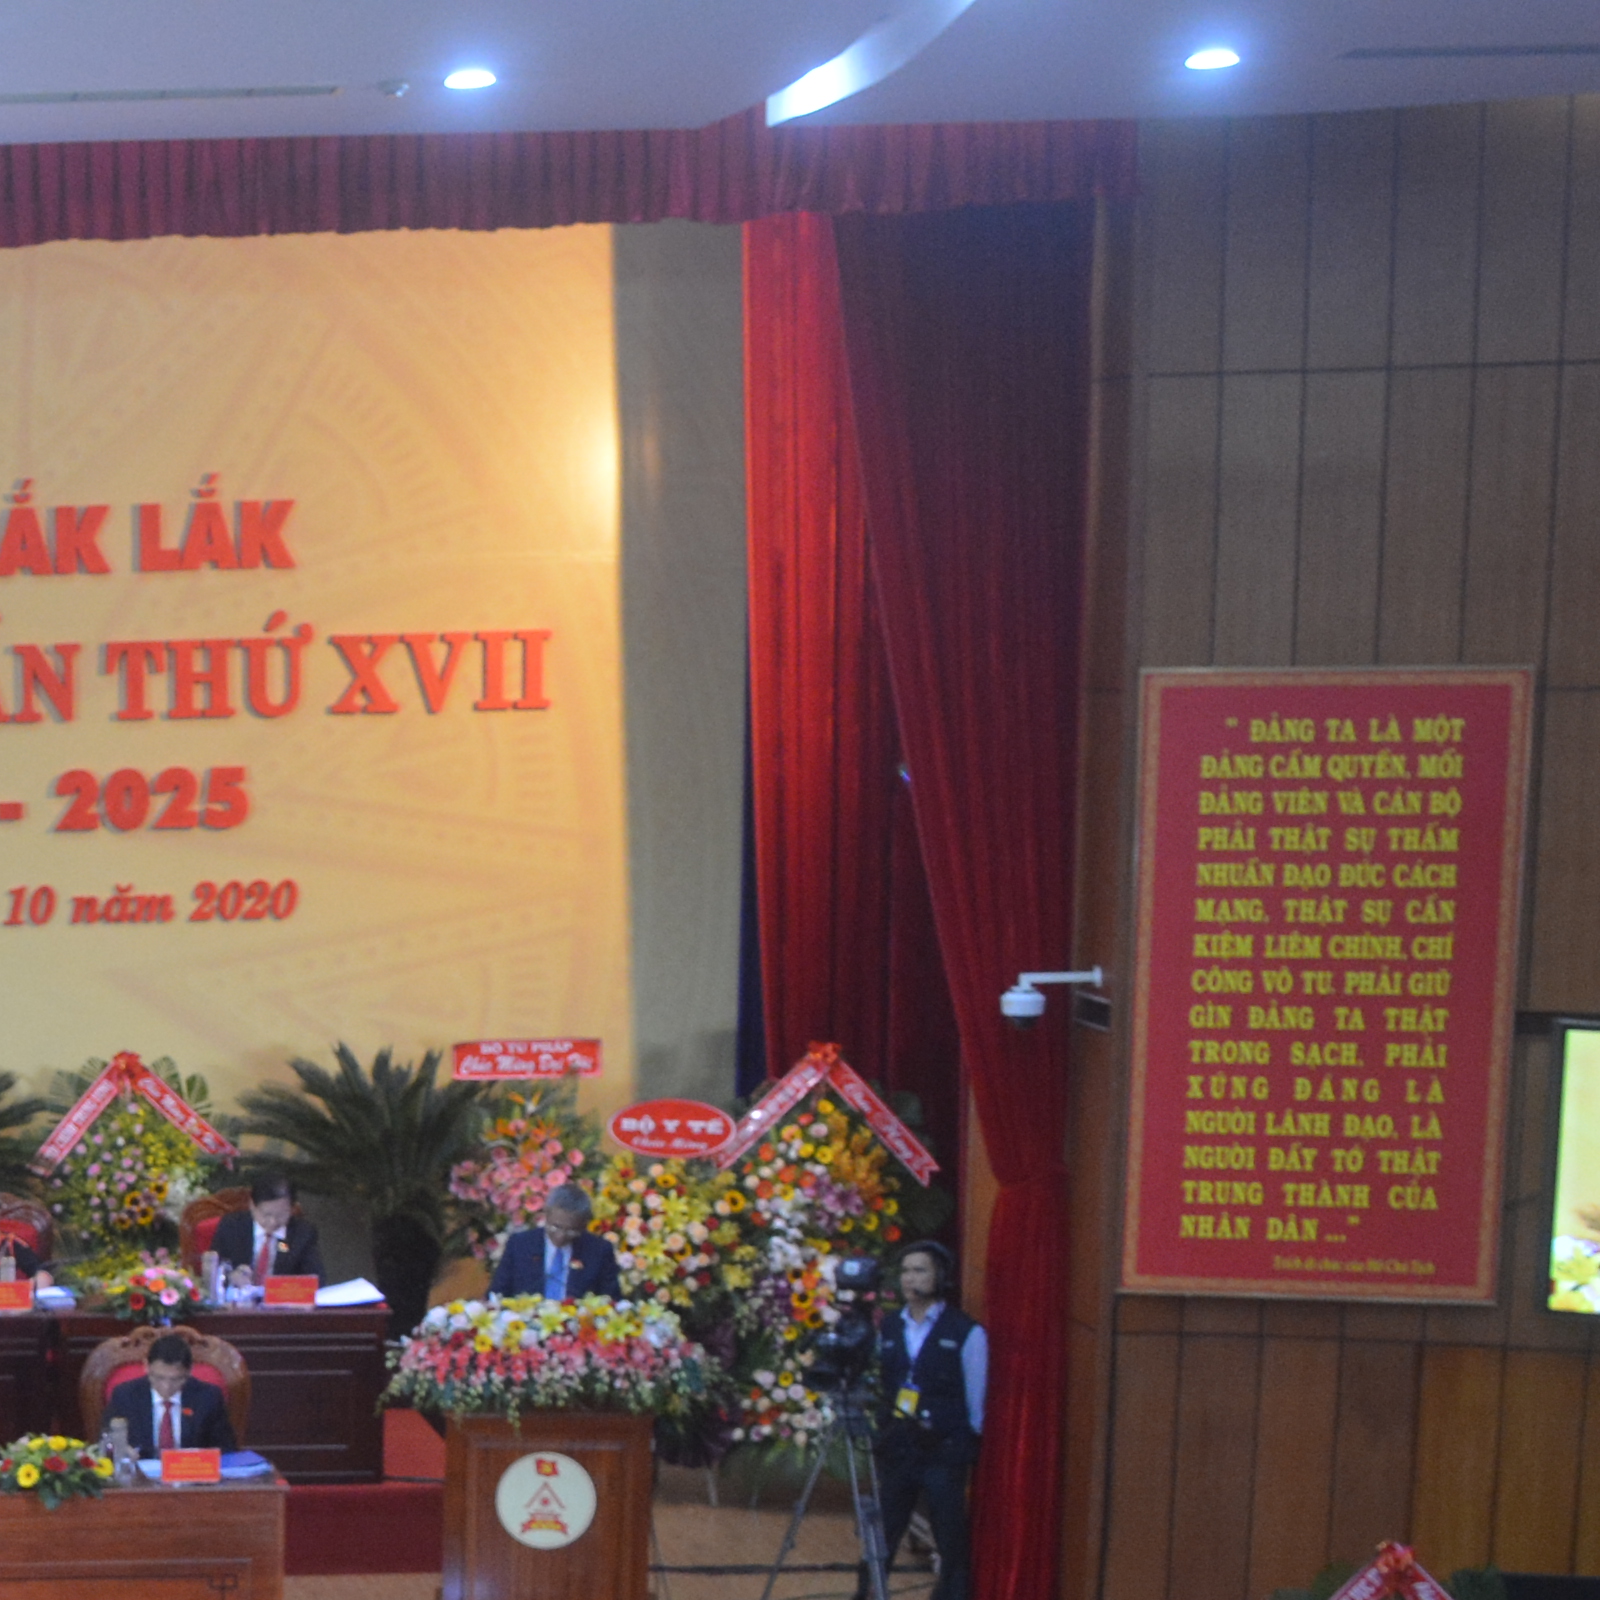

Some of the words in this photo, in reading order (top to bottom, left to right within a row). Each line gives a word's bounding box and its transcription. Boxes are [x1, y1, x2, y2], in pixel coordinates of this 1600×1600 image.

[140, 473, 298, 572] LẮK
[107, 610, 318, 720] THỨ
[332, 626, 558, 714] XVII
[57, 765, 251, 830] 2025
[8, 886, 56, 924] 10
[73, 886, 175, 923] năm
[191, 879, 299, 920] 2020
